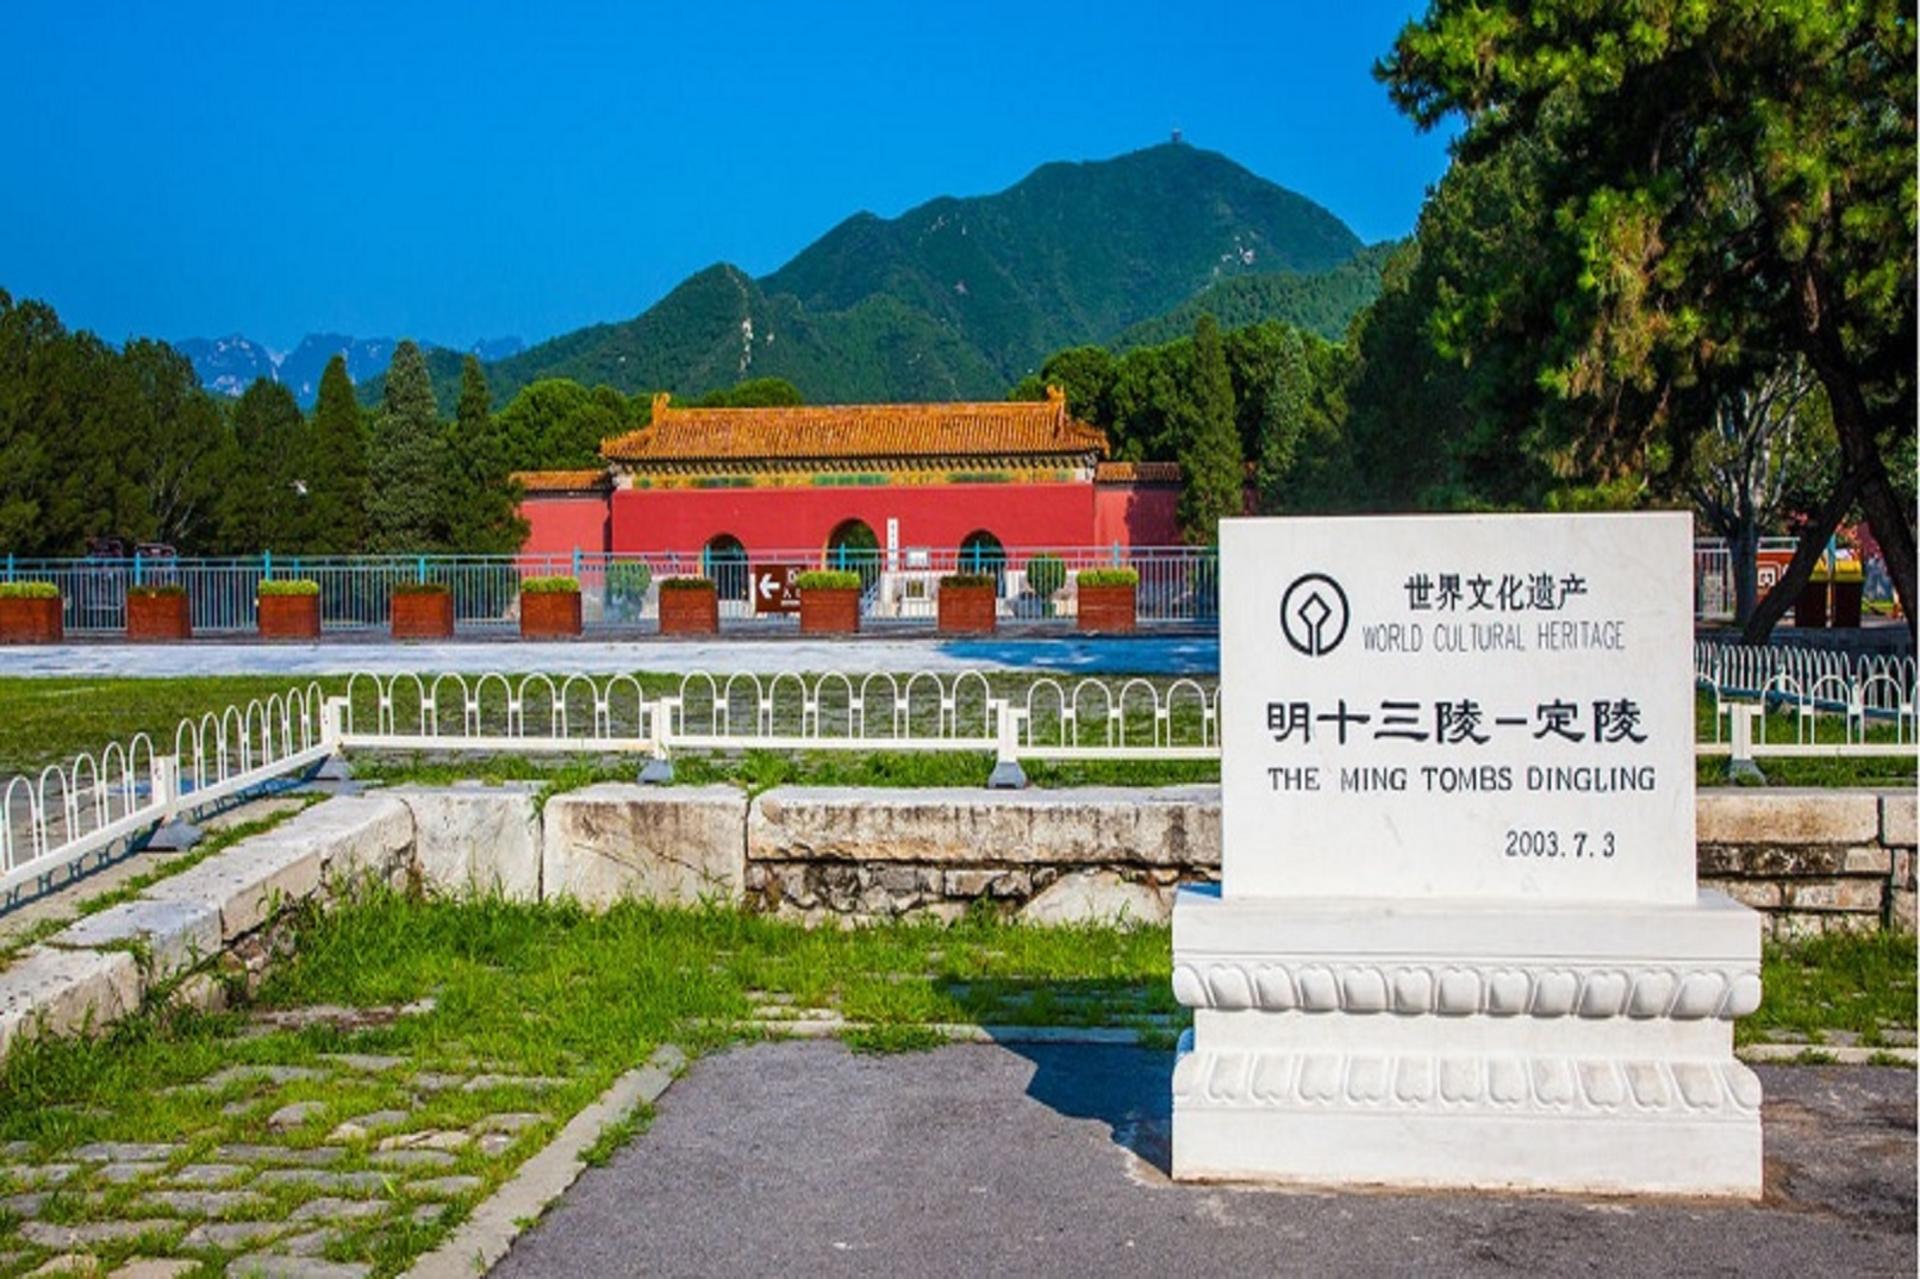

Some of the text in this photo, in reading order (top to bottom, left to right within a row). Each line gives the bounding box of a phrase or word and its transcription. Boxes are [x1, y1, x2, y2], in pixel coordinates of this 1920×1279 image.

[1403, 571, 1588, 612] 世界文化遗产
[1362, 620, 1626, 653] WORLD CULTURAL HERITAGE
[1267, 765, 1656, 794] THE MING TOMBS DINGLING
